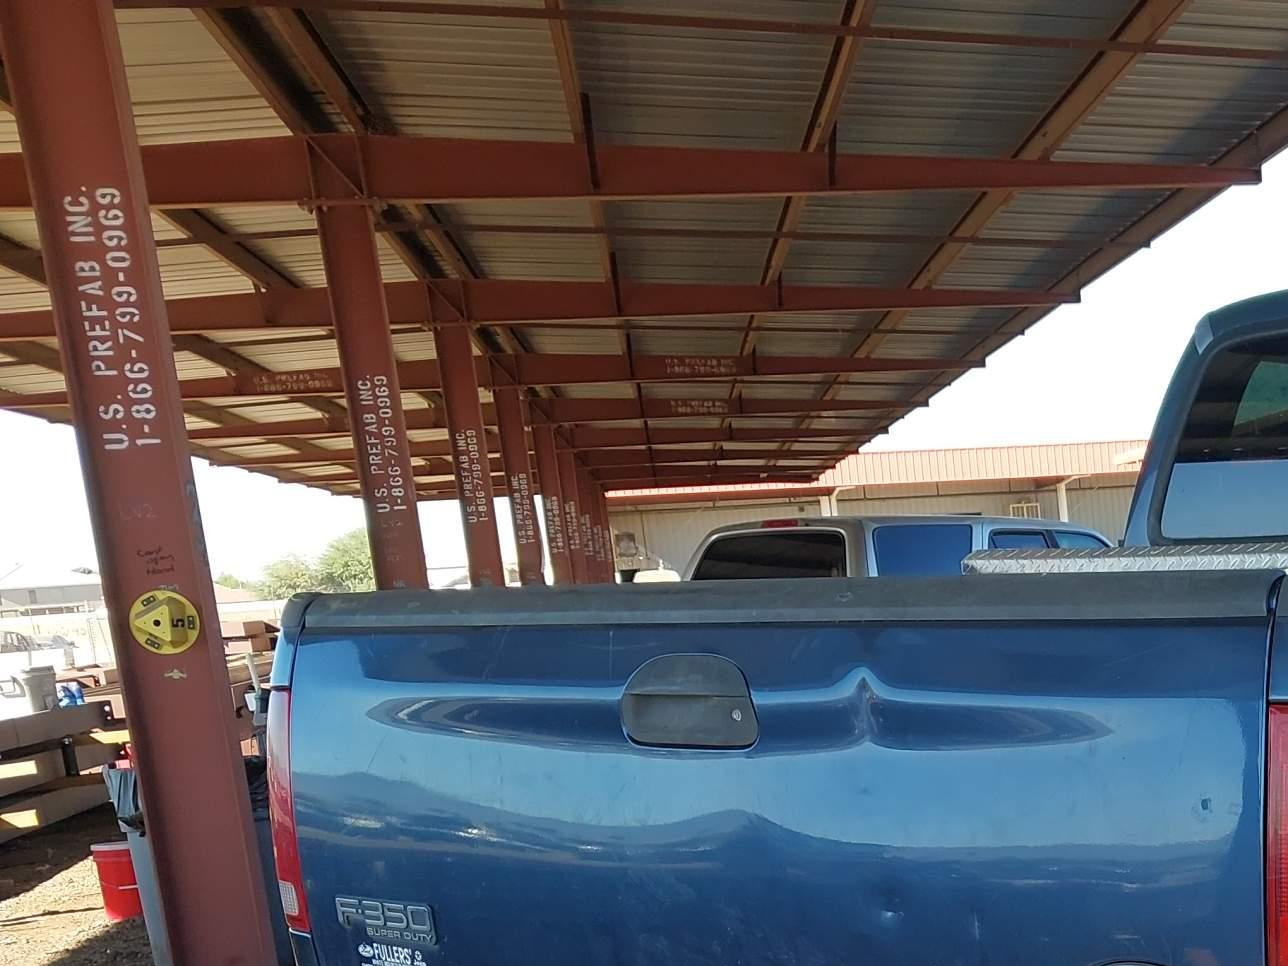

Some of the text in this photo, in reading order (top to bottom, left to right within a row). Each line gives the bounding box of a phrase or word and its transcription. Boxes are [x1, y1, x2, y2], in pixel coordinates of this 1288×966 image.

[64, 185, 130, 450] U.S. PREFAB INC.
[95, 187, 161, 448] 1-866-799-0969
[357, 375, 391, 513] U.S. PREFAB INC.
[374, 375, 407, 510] 1-866-799-0969
[455, 429, 478, 523] U.S. PREFAB INC.
[466, 429, 488, 521] 1-866-799-0969
[366, 927, 433, 943] SUPER DUTY
